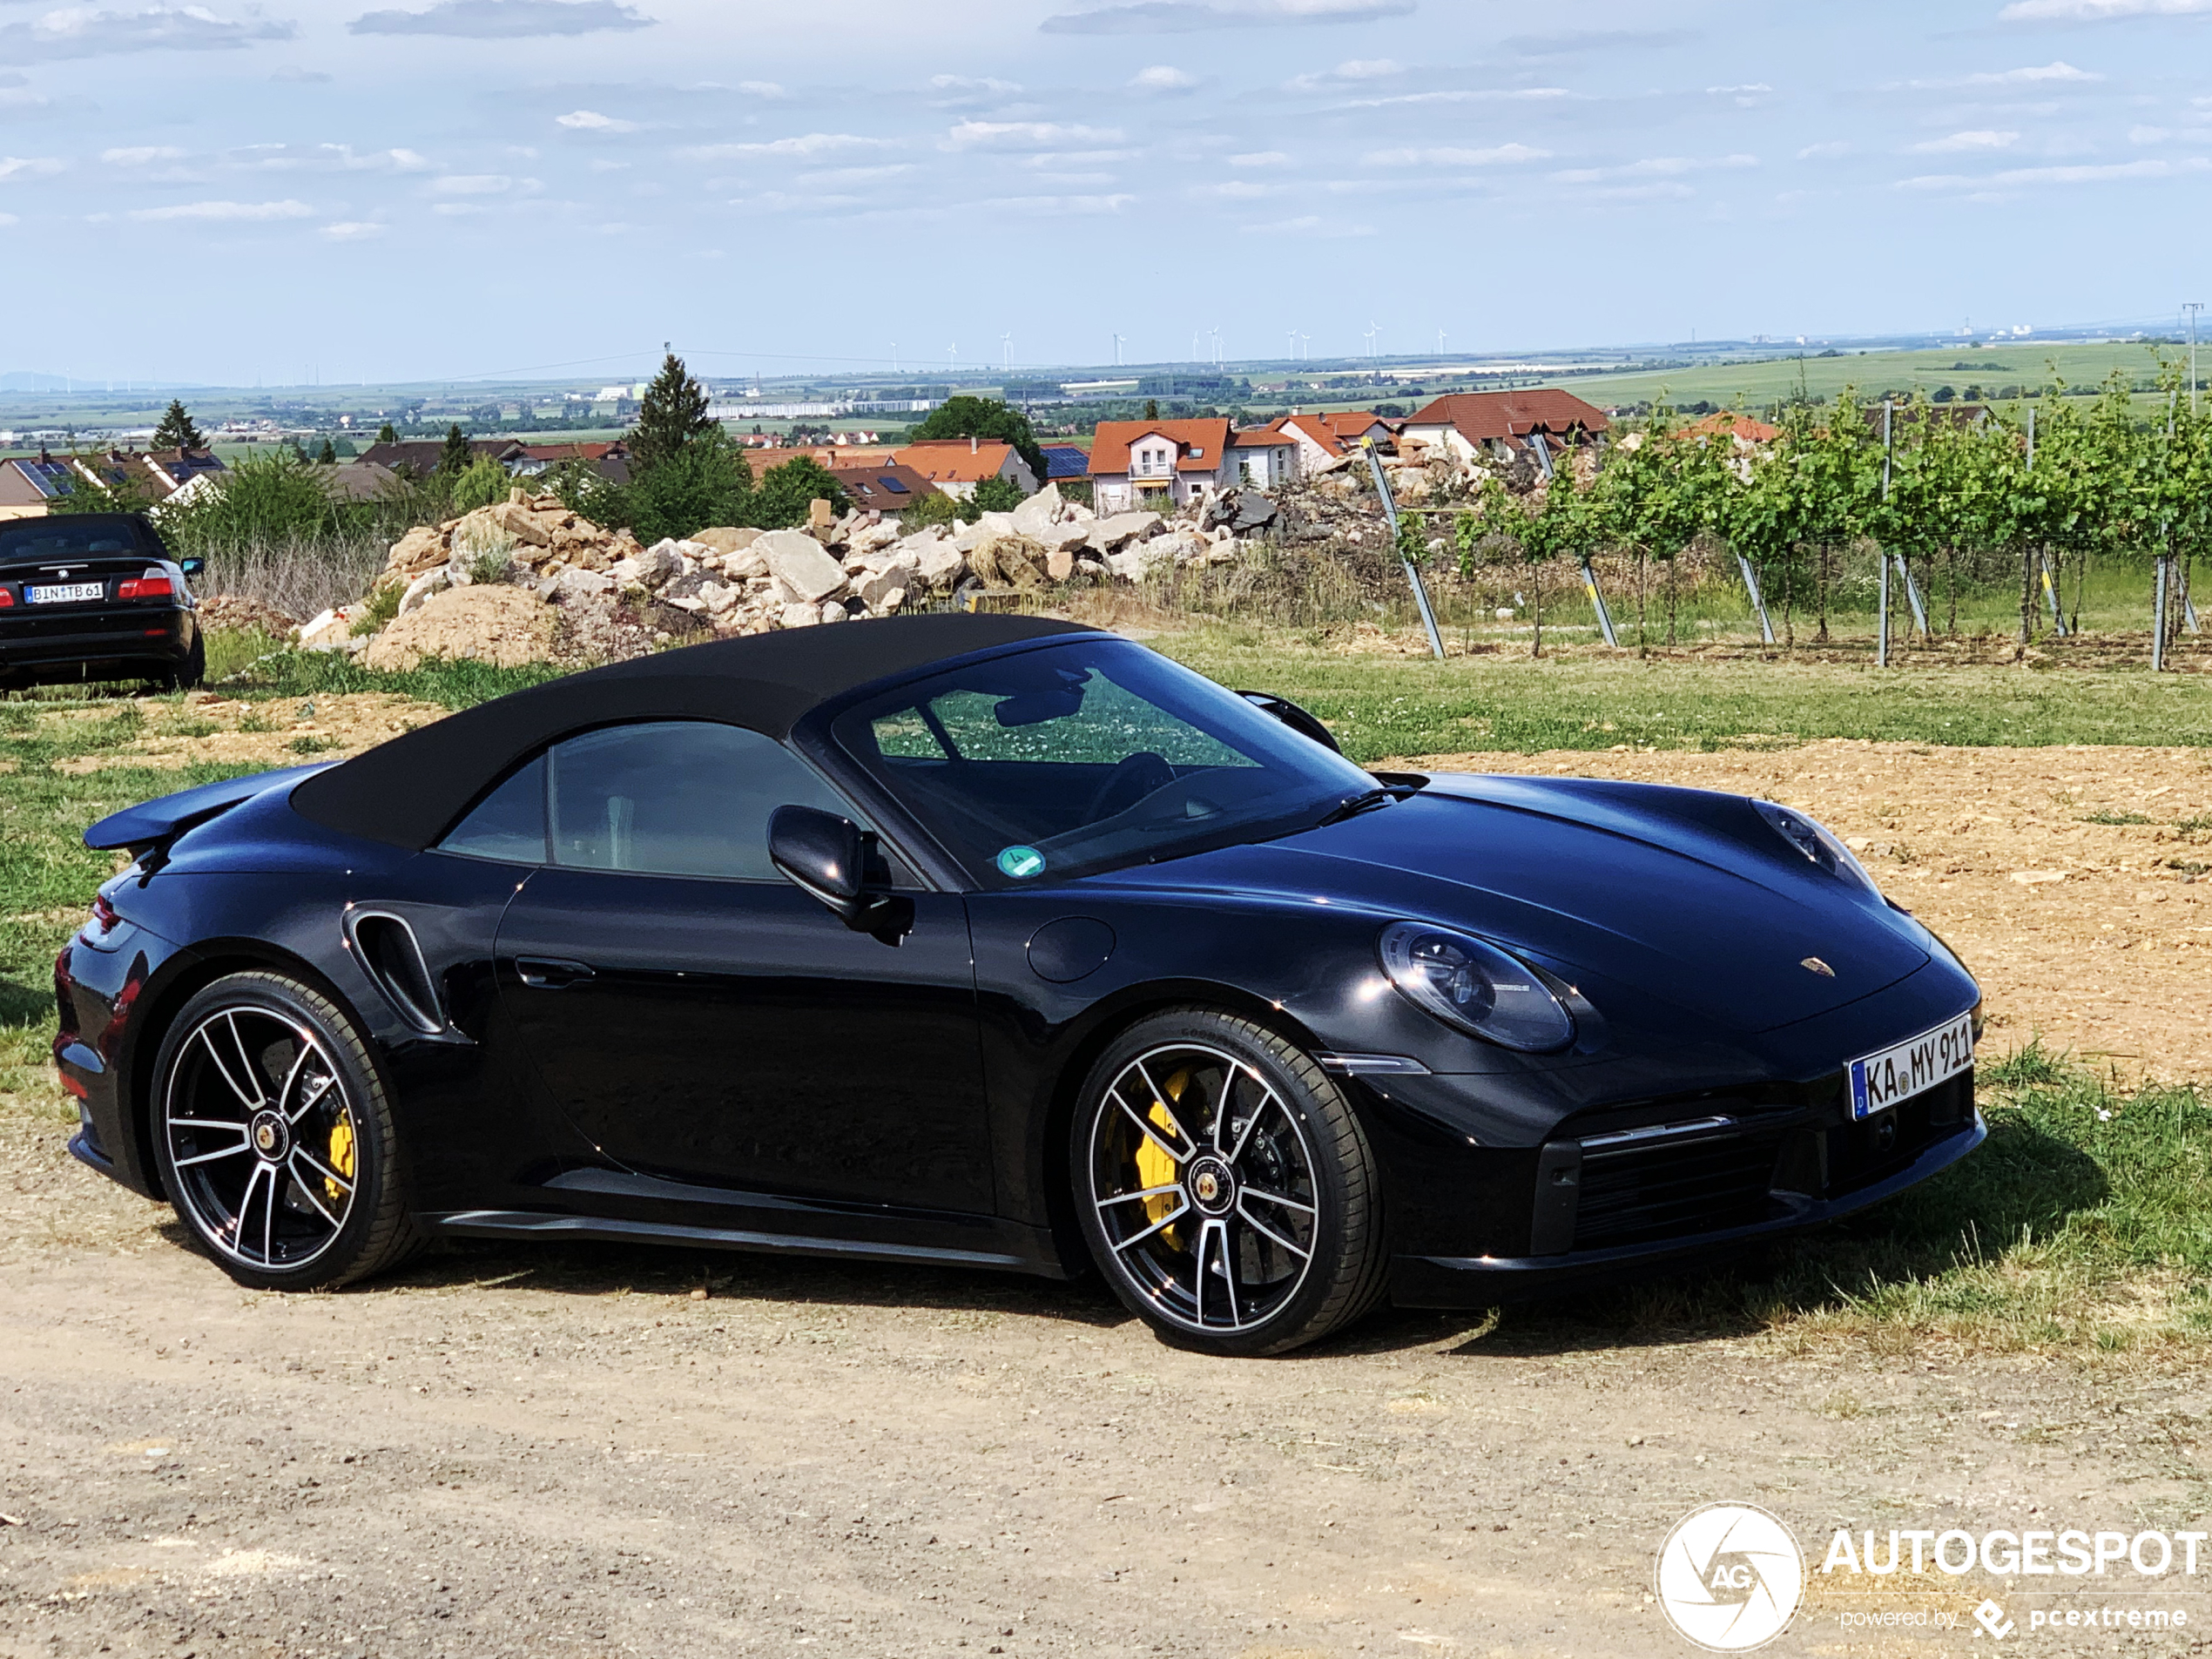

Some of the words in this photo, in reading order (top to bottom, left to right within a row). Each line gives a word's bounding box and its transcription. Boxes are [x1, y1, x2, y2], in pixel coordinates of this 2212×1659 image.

[34, 587, 58, 600] BIN
[66, 585, 83, 597] TB
[85, 584, 101, 597] 61
[1009, 852, 1024, 864] 4
[1866, 1057, 1898, 1108] KA
[1911, 1038, 1935, 1089] MY
[1939, 1022, 1972, 1074] 911
[1858, 1096, 1864, 1109] D
